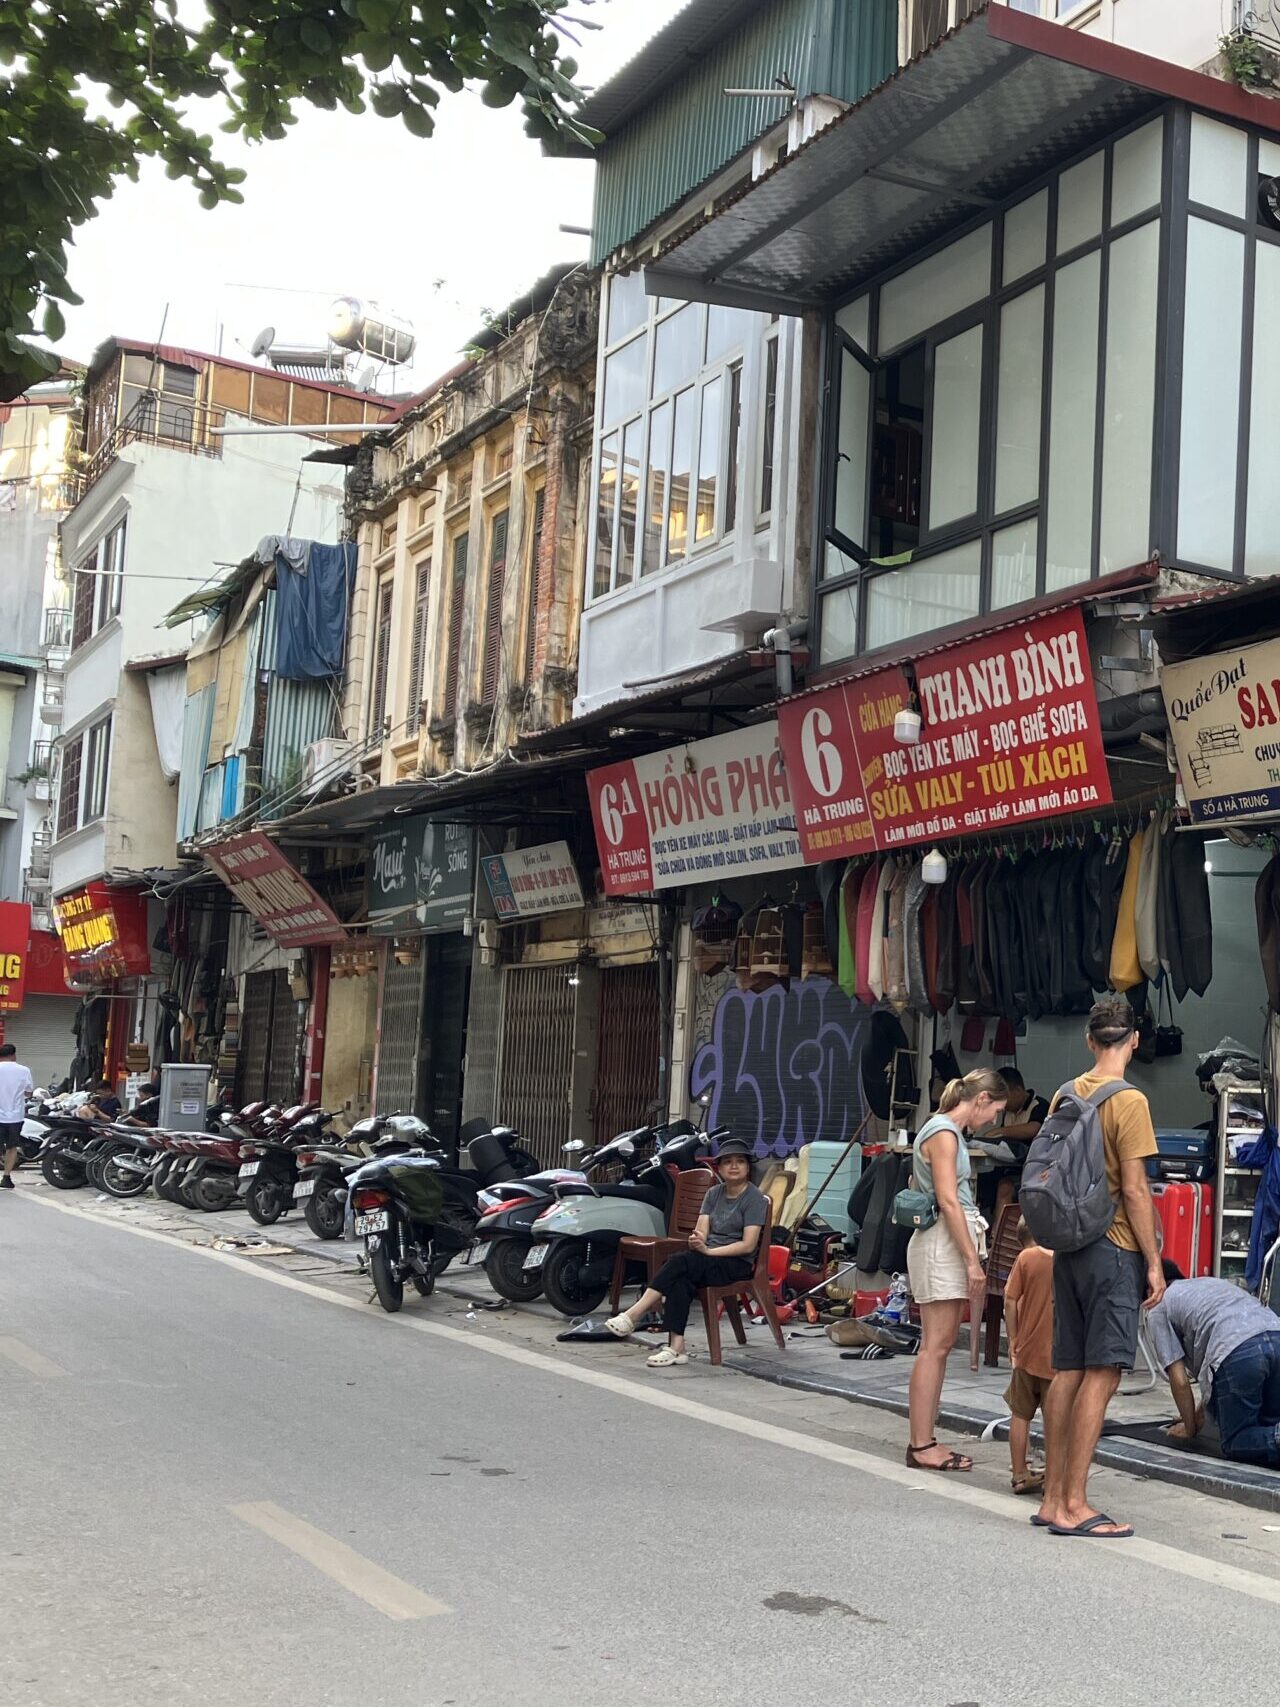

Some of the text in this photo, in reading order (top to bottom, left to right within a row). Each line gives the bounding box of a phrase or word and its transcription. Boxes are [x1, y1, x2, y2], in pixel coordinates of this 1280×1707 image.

[920, 631, 1084, 725] THANH BÌNH
[1171, 658, 1247, 721] Quốc Đạt
[801, 707, 843, 797] 6
[883, 749, 908, 783] BỌC
[933, 737, 952, 767] XE
[951, 726, 980, 762] MÁY
[990, 719, 1018, 755] BỌC
[1020, 703, 1049, 745] GHẾ
[1050, 701, 1088, 742] SOFA
[644, 738, 791, 836] HỒNG PHÁ
[803, 804, 821, 825] HÀ
[822, 797, 864, 822] TRUNG
[871, 779, 913, 821] SỬA
[915, 770, 964, 812] VALY
[977, 754, 1016, 796] TÚI
[1019, 741, 1088, 787] XÁCH
[884, 824, 905, 843] LÀM
[906, 820, 925, 838] MỚI
[941, 816, 956, 831] DA
[964, 806, 987, 828] GIẶT
[989, 801, 1010, 822] HẤP
[1012, 797, 1036, 816] LÀM
[1038, 790, 1061, 809] MỚI
[1063, 786, 1079, 806] ÁO
[1081, 785, 1099, 803] DA
[1202, 794, 1270, 816] SỐ 4 HÀ TRUNG
[607, 848, 646, 870] HÀ TRUNG
